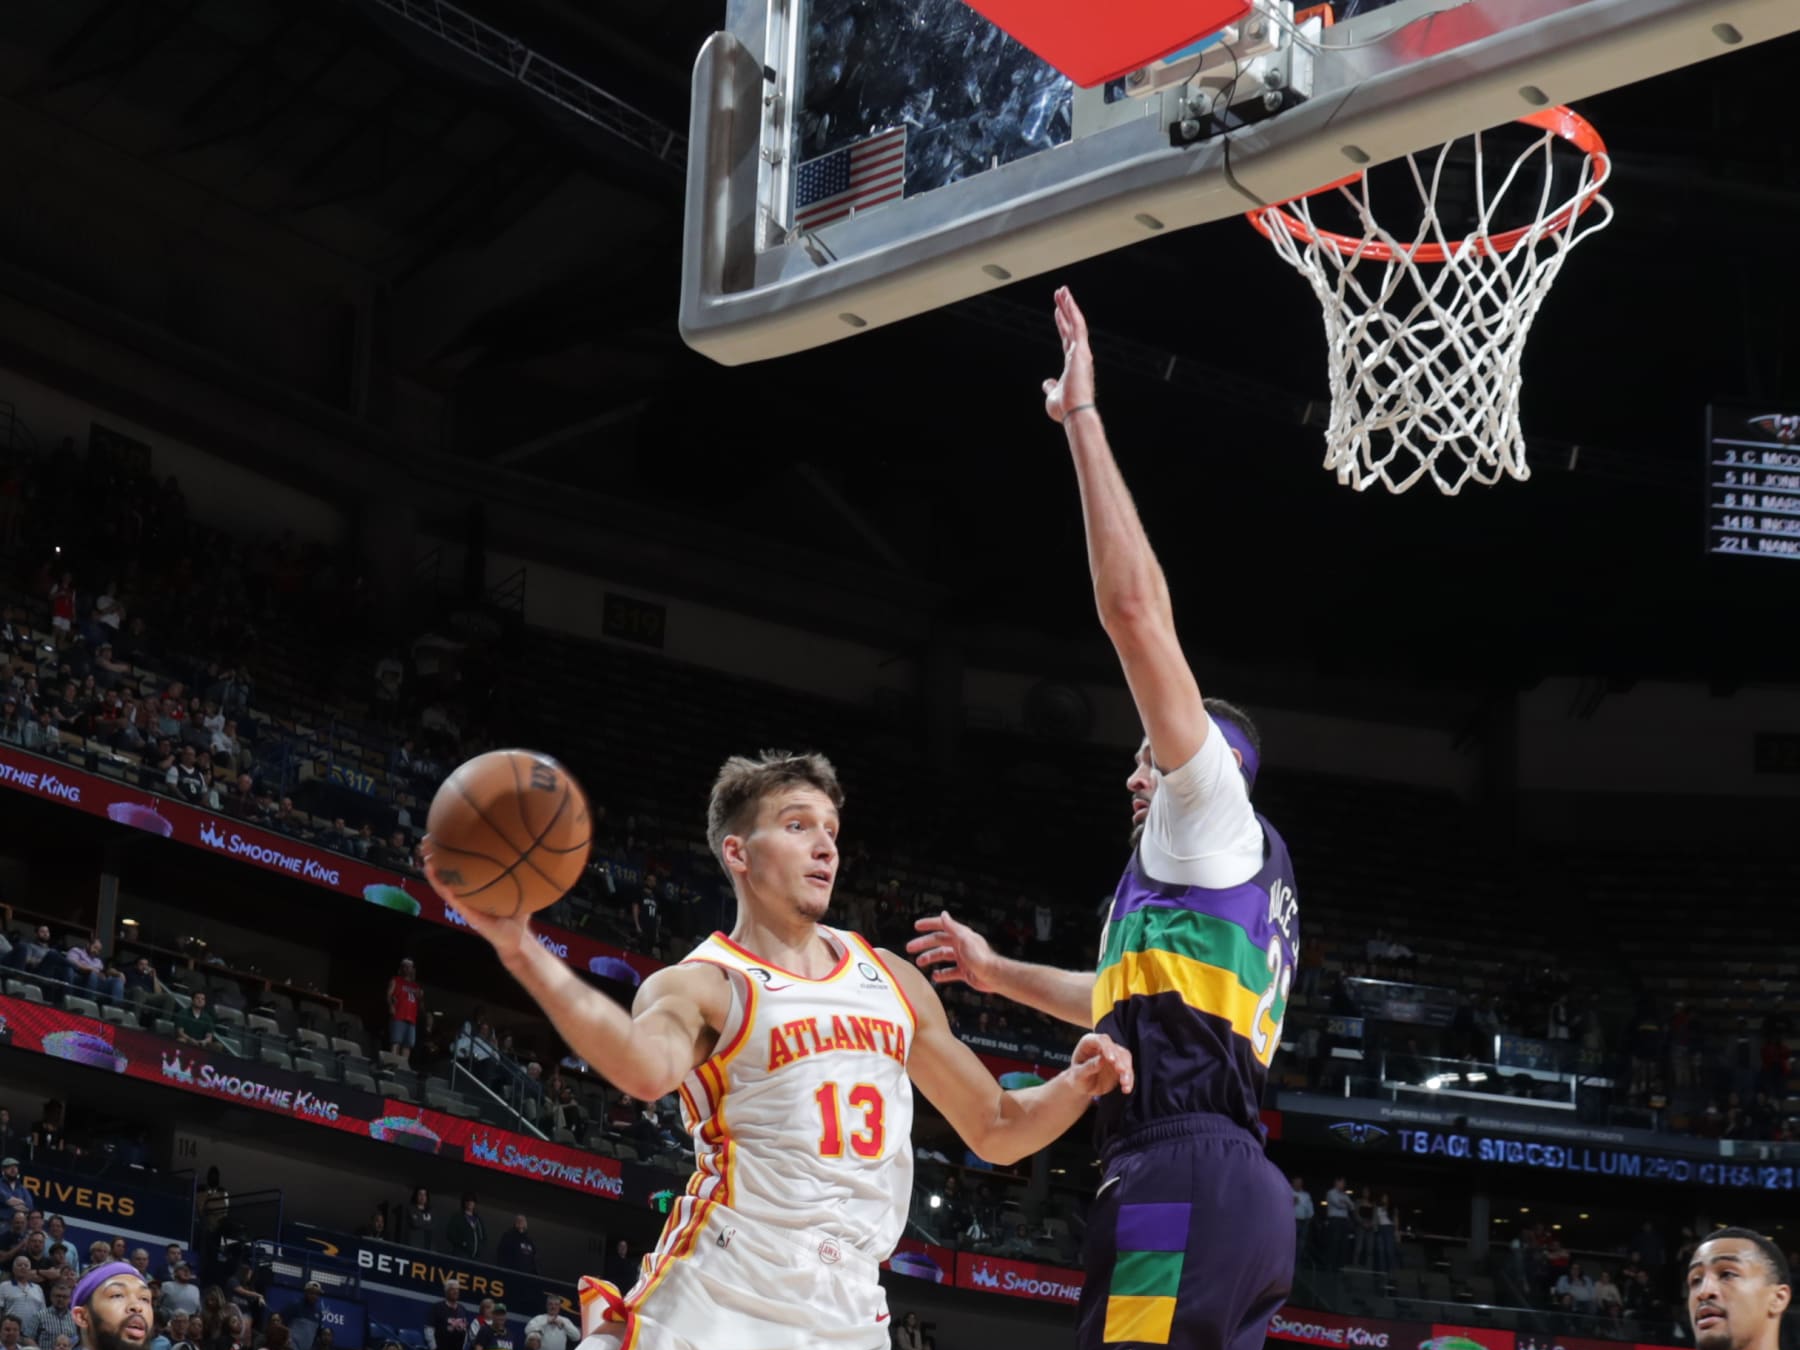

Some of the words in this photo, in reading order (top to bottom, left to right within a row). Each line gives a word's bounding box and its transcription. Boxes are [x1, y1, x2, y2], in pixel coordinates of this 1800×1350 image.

[1742, 450, 1756, 464] C
[1722, 514, 1740, 529] 14
[1719, 536, 1740, 551] 22
[347, 769, 374, 793] 317
[228, 835, 302, 873] SMOOTHIE
[768, 1014, 906, 1073] ATLANTA
[961, 1033, 997, 1048] PLAYERS
[998, 1040, 1018, 1053] PASS
[198, 1065, 292, 1109] SMOOTHIE
[814, 1081, 885, 1160] 13
[501, 1145, 583, 1184] SMOOTHIE
[23, 1175, 136, 1217] RIVERS
[1002, 1272, 1082, 1301] SMOOTHIE
[1269, 1315, 1344, 1343] SMOOTHIE
